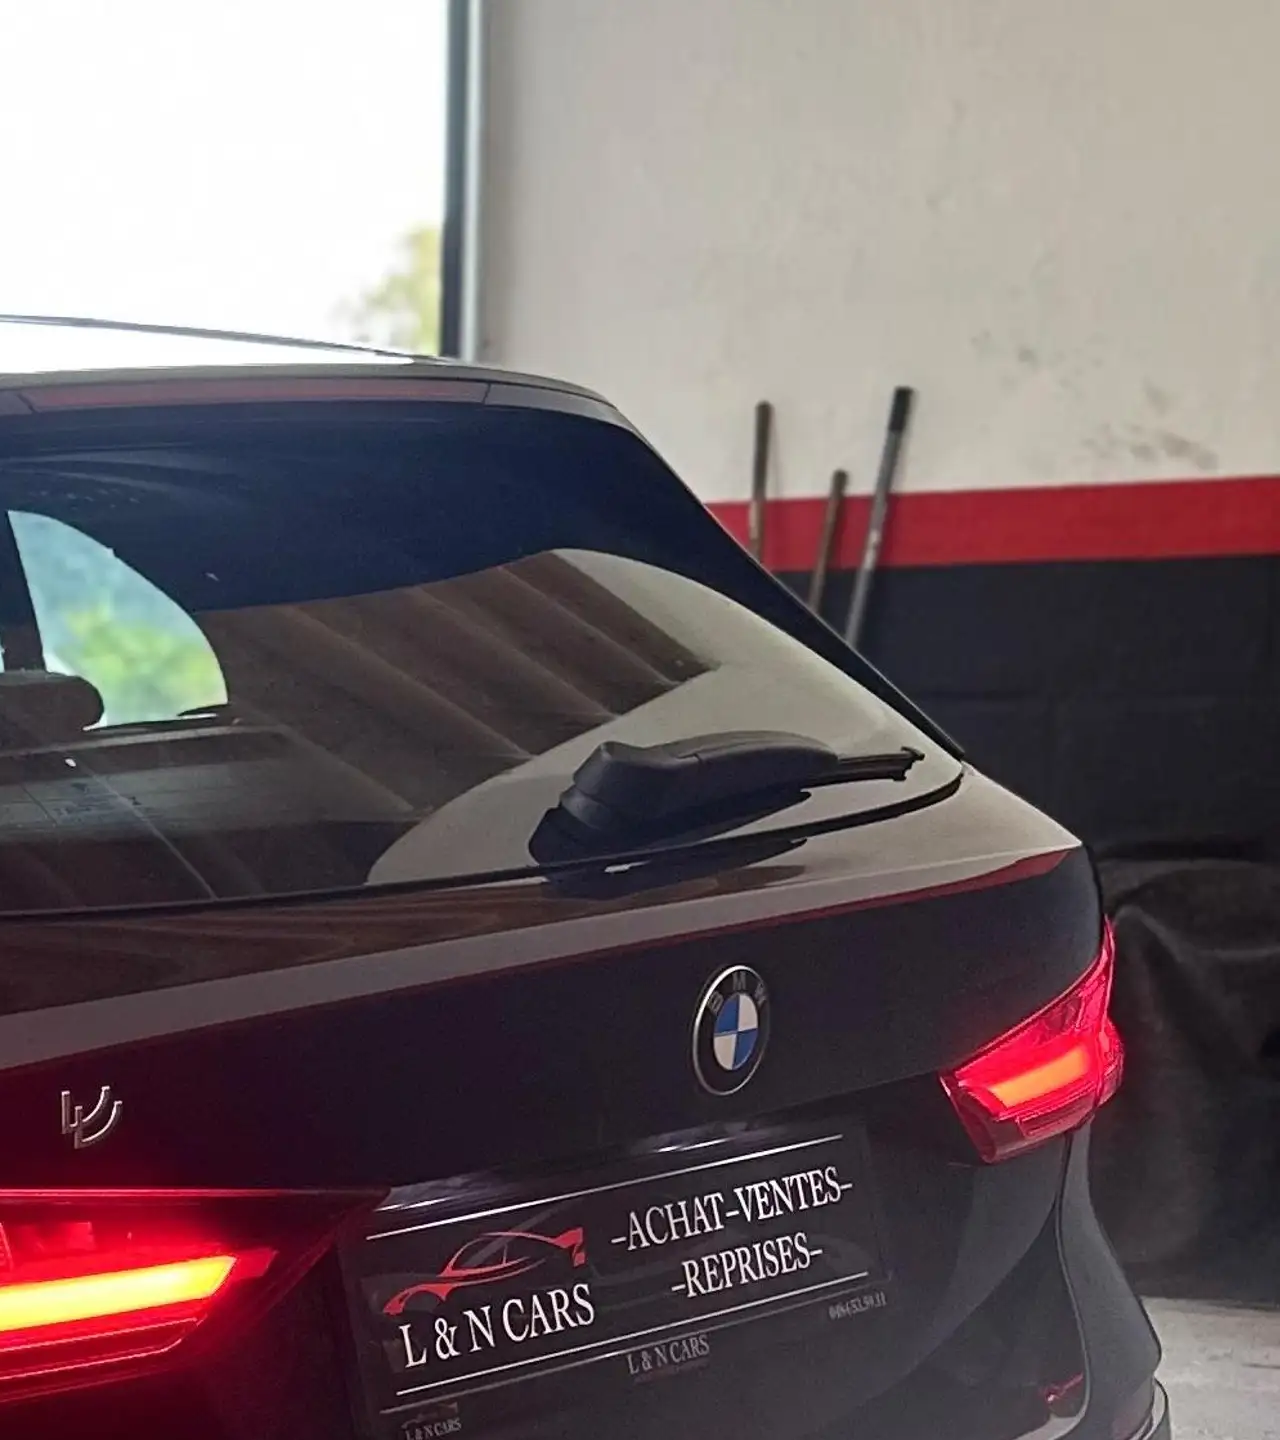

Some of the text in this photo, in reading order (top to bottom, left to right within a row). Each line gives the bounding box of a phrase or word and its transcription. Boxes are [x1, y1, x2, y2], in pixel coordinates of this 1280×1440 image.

[672, 1232, 823, 1297] -REPRISES-
[399, 1283, 595, 1368] L & N CARS
[626, 1334, 710, 1375] L & N CARS
